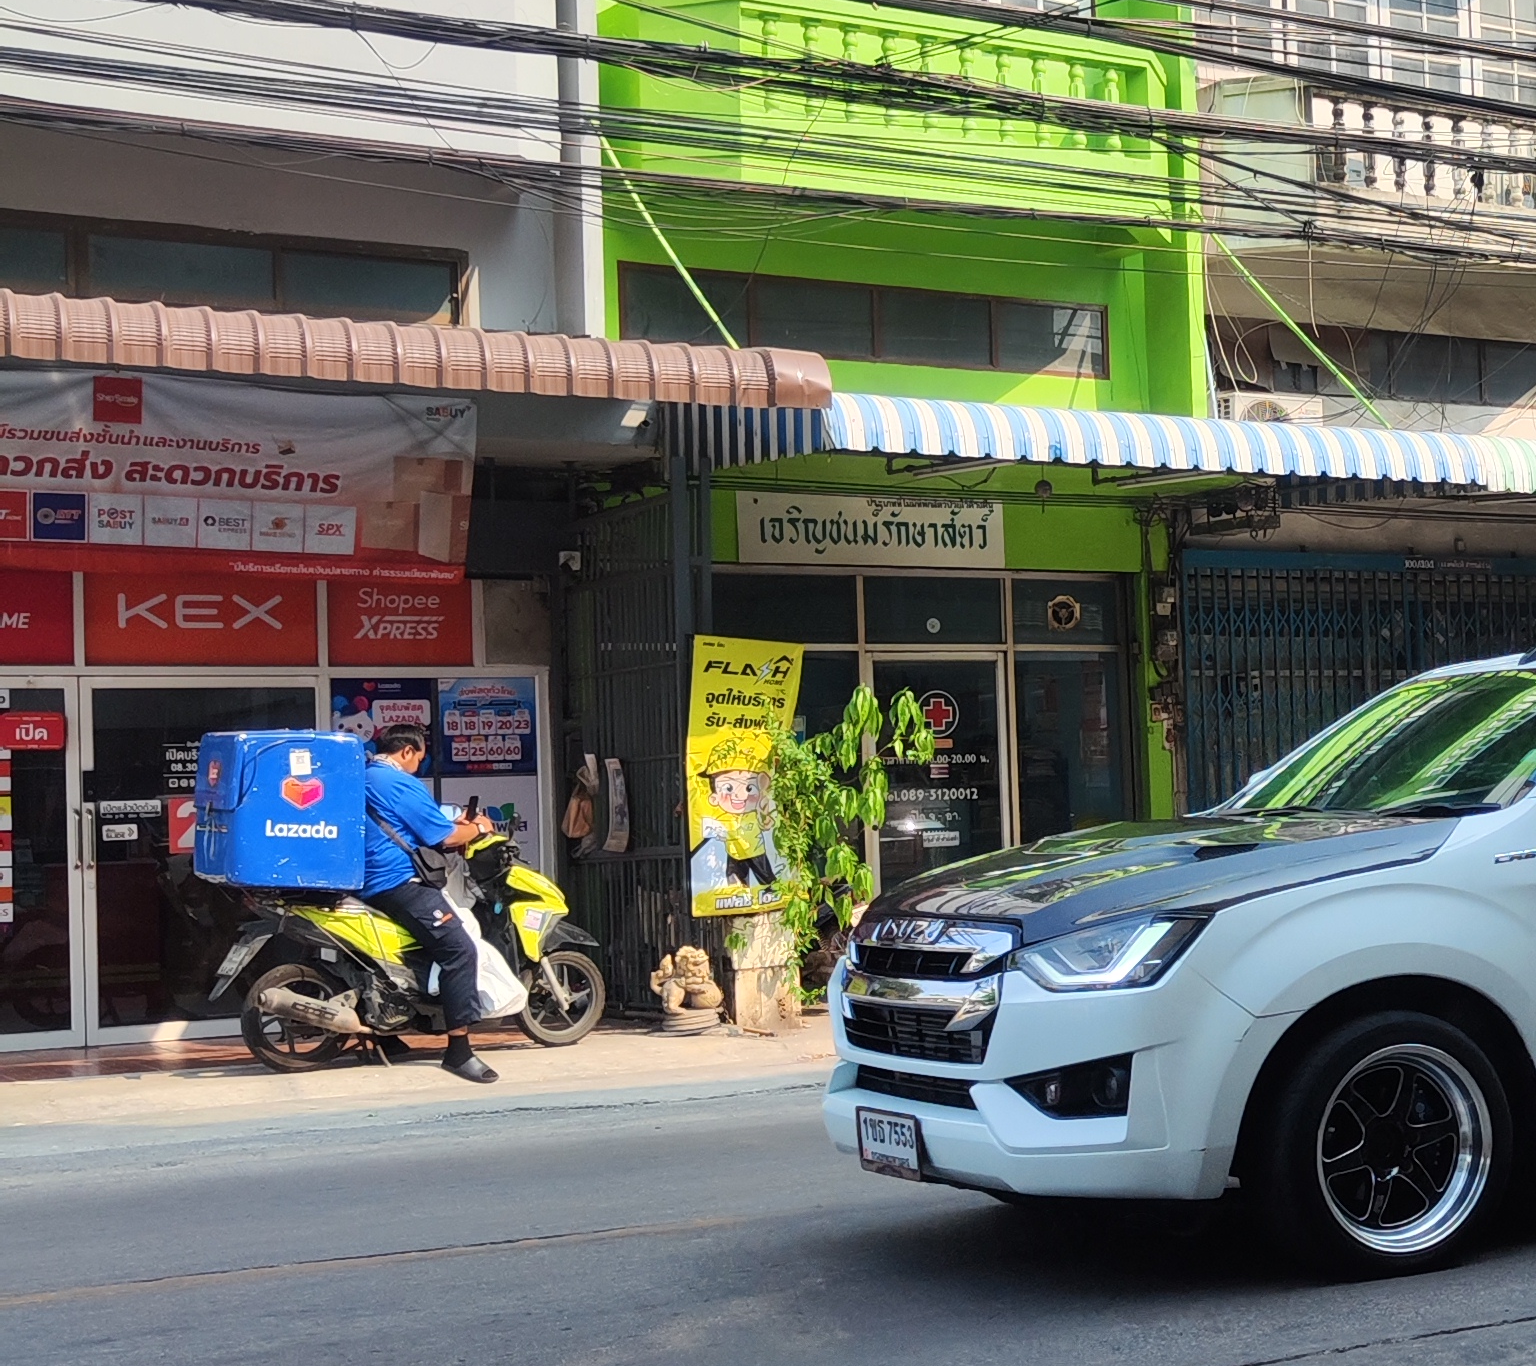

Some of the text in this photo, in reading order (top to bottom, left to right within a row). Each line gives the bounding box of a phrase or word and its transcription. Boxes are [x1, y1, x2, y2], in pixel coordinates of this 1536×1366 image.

[218, 517, 248, 528] BEST
[317, 522, 344, 534] SPX
[117, 592, 284, 630] KEX
[356, 587, 441, 614] Shopee
[353, 614, 443, 640] XPRESS
[15, 723, 48, 741] เปิด
[446, 719, 530, 731] 18 18 19 20 23
[453, 746, 520, 757] 25 25 60 60
[265, 819, 338, 840] Lazada
[871, 917, 947, 945] ISUZU
[886, 1120, 915, 1150] 7553
